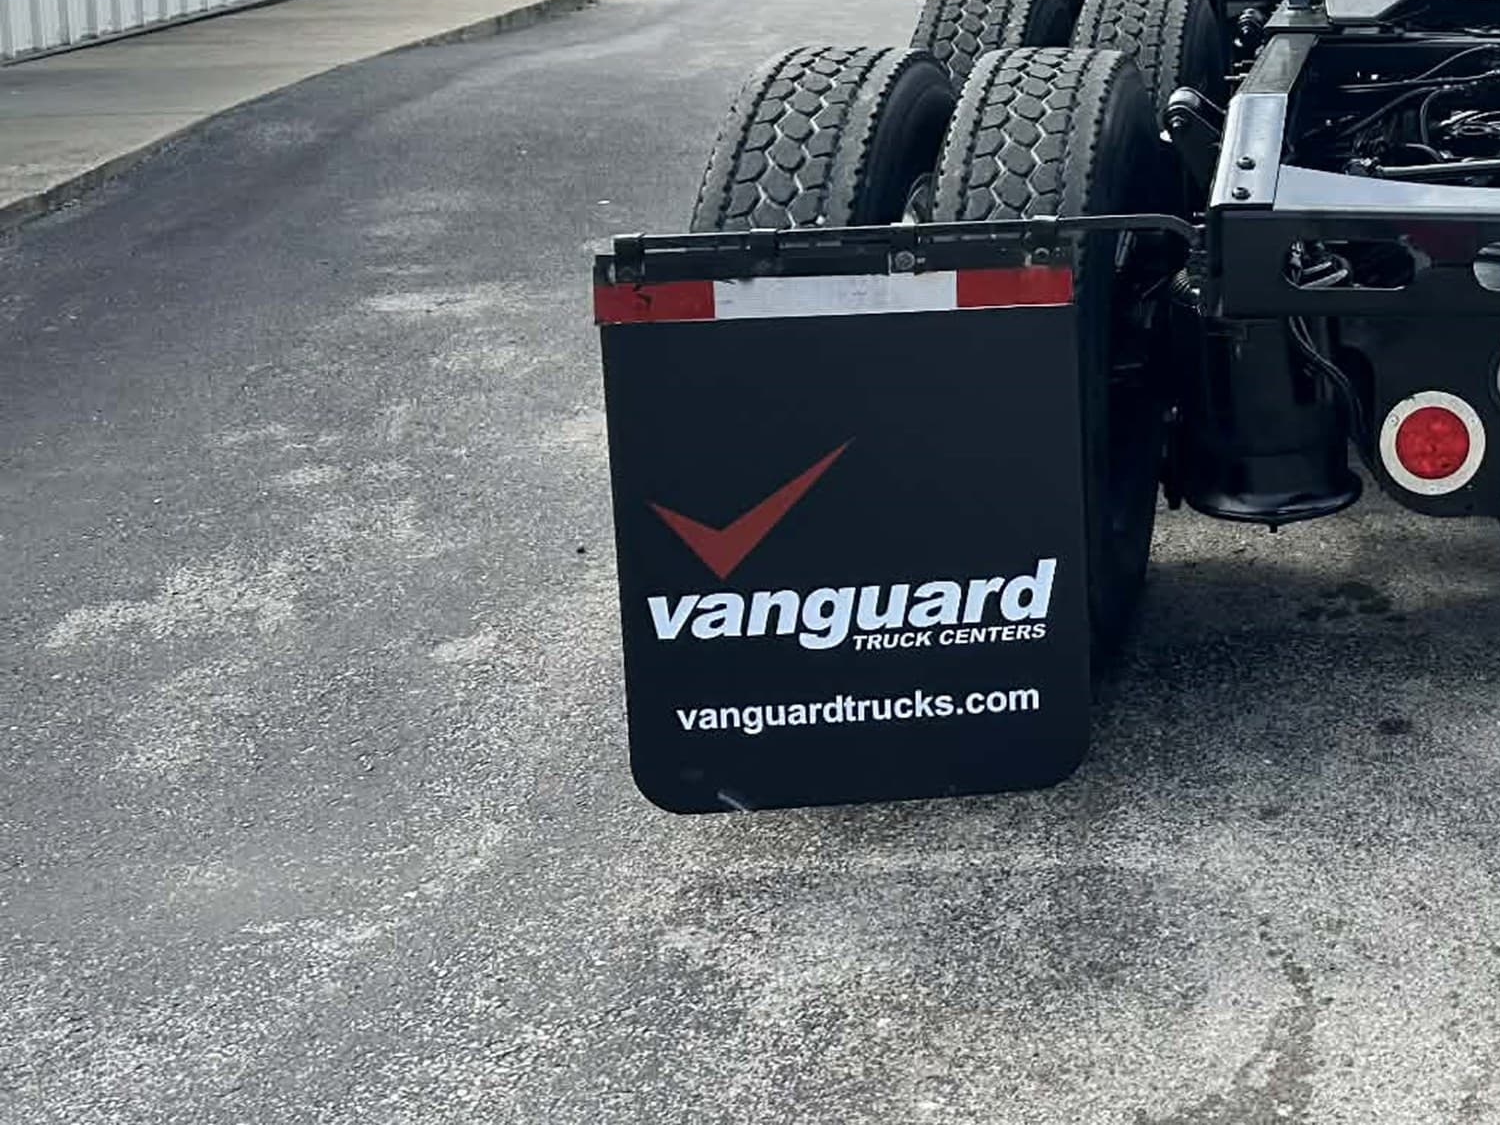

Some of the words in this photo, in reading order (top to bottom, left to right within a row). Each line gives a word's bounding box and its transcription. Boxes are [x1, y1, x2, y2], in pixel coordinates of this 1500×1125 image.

[646, 558, 1057, 650] vanguard
[852, 631, 932, 651] TRUCK
[938, 623, 1046, 646] CENTERS
[677, 688, 1039, 734] vanguardtrucks.com
